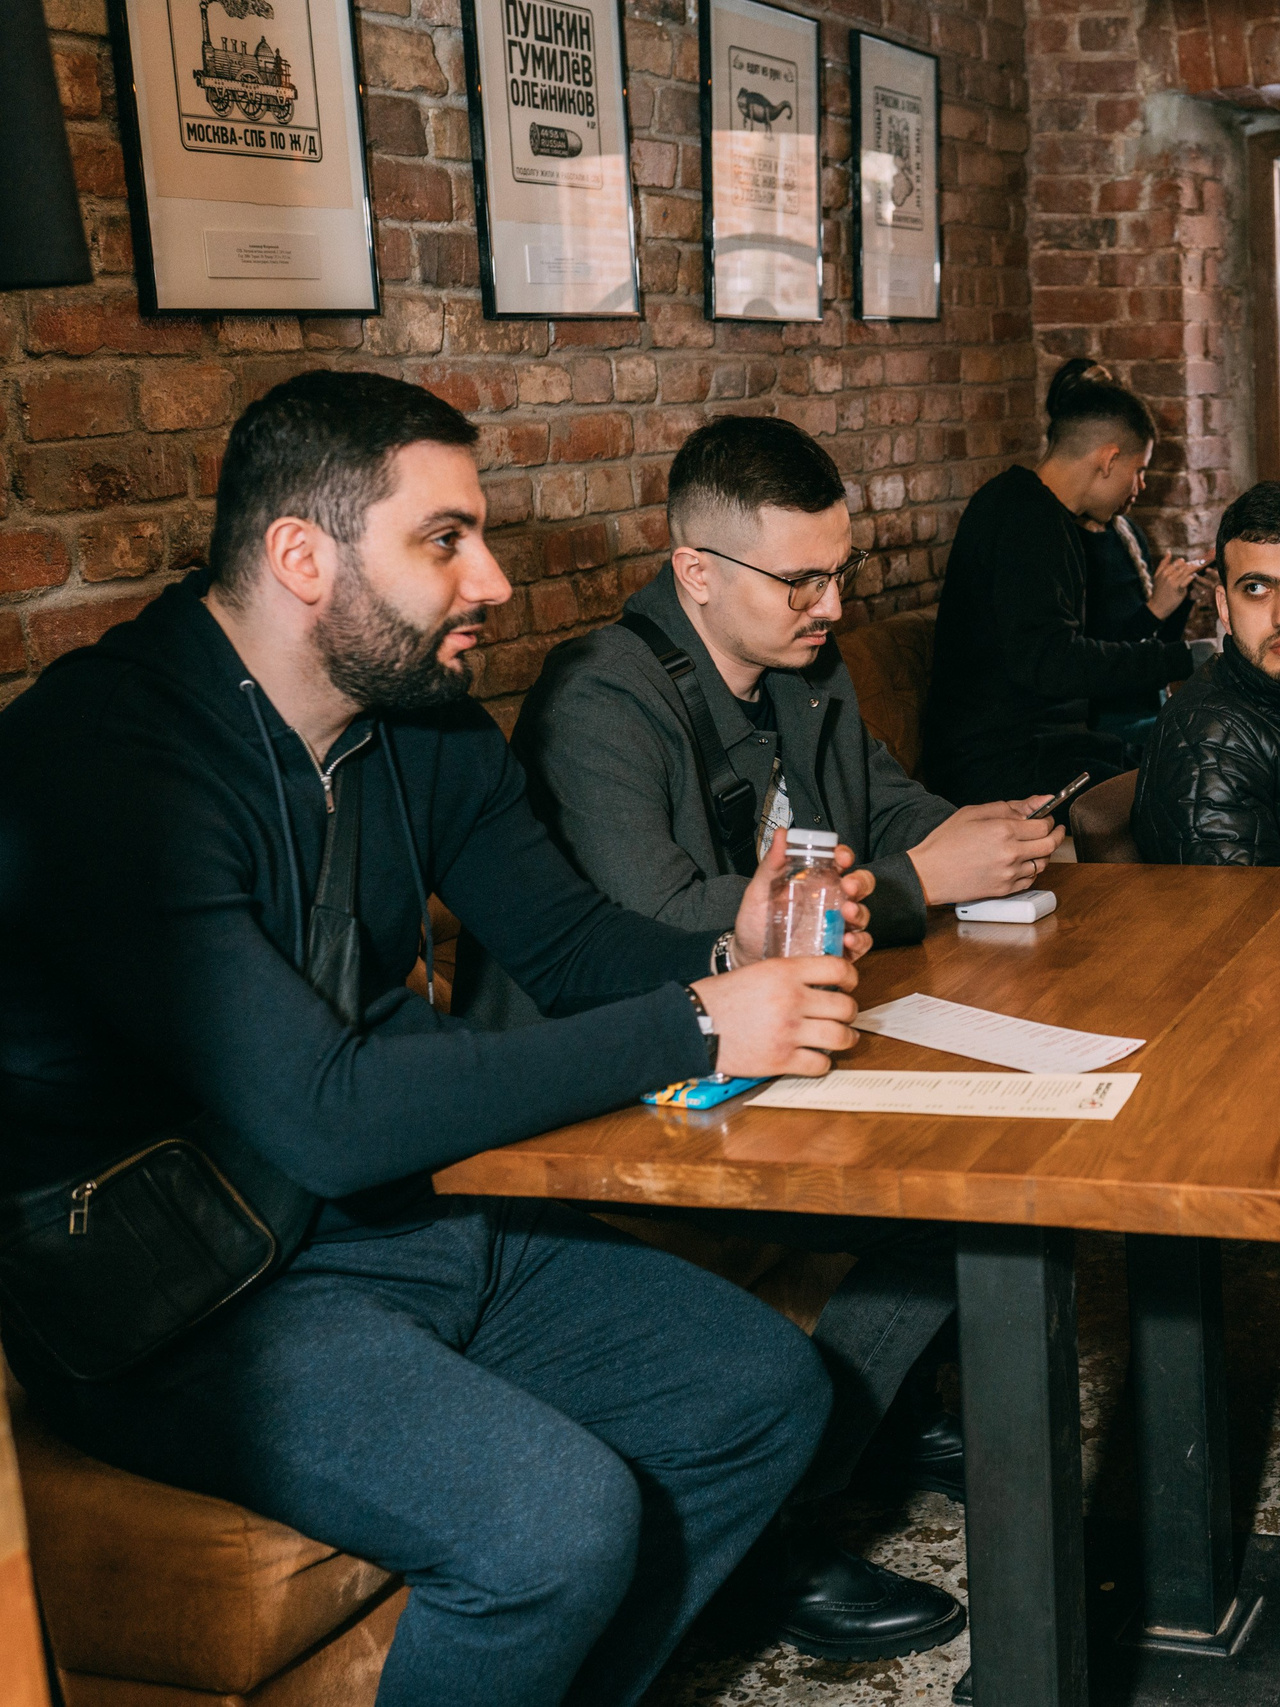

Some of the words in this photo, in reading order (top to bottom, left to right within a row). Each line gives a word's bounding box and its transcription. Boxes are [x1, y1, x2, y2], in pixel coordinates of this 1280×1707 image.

[505, 0, 592, 52] ПУШКИН
[186, 122, 267, 148] МОСКВА-СПБ
[270, 131, 286, 150] ПО
[289, 133, 318, 156] Ж/Д
